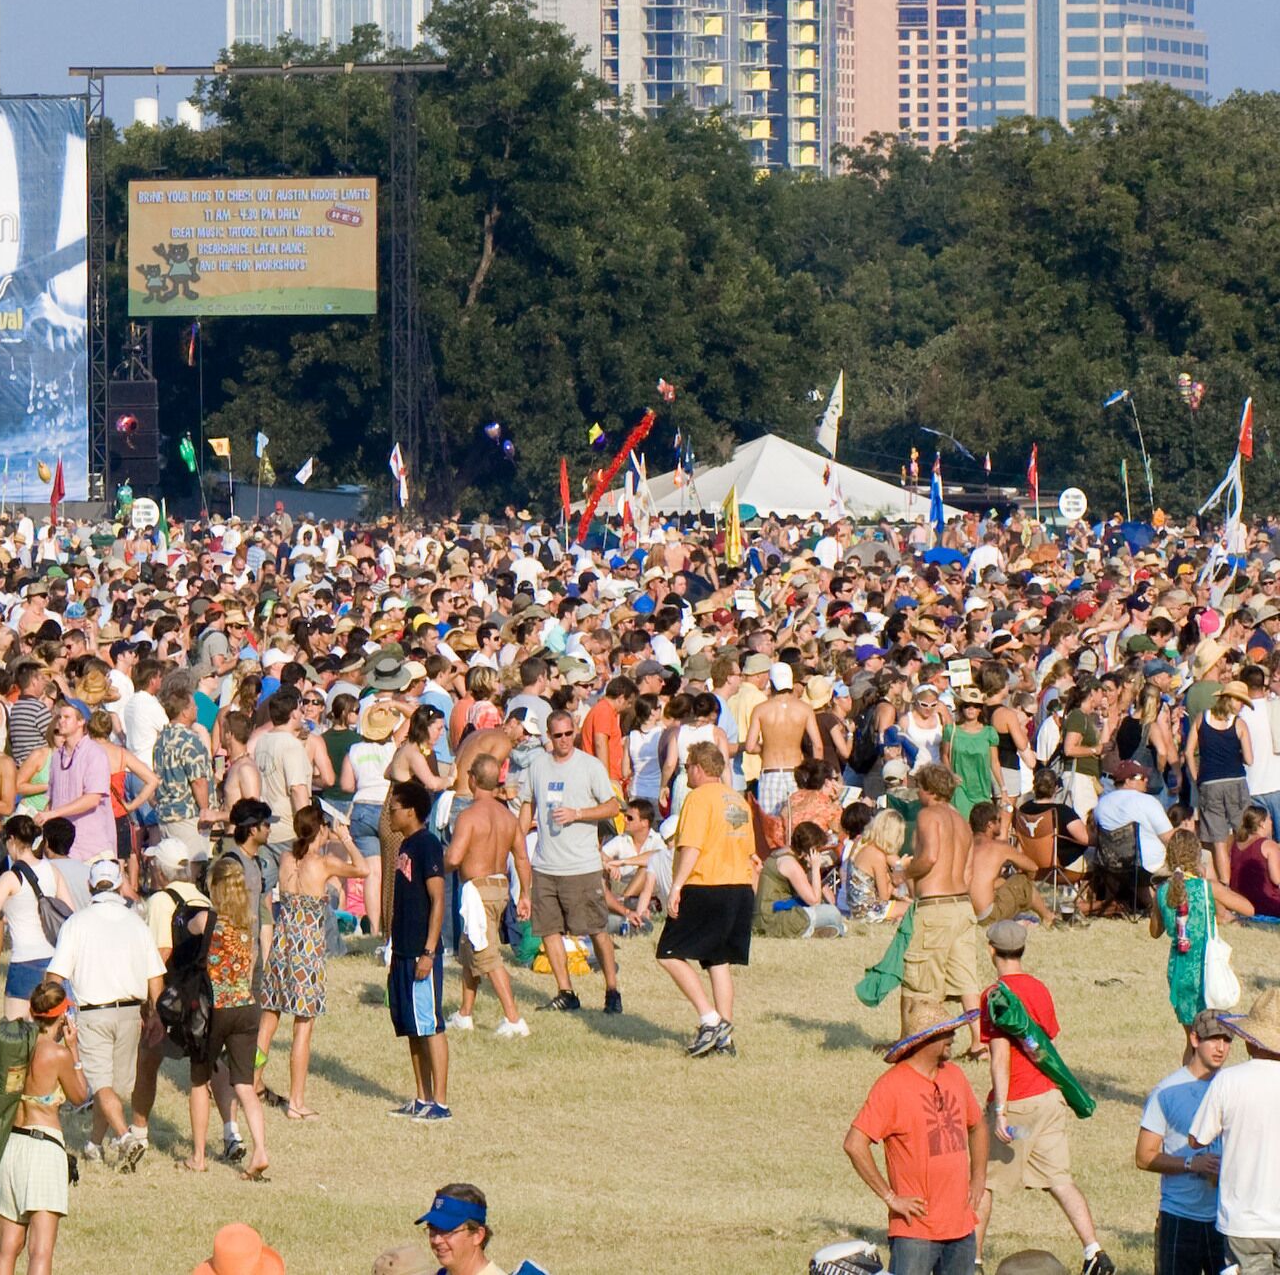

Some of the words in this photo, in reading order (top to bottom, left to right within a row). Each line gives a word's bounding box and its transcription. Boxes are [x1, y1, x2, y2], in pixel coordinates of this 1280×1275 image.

[166, 190, 189, 203] YOUR
[214, 189, 225, 202] TO
[256, 189, 272, 201] OUT
[205, 209, 213, 221] 11
[215, 209, 231, 221] AM
[261, 208, 275, 220] PM
